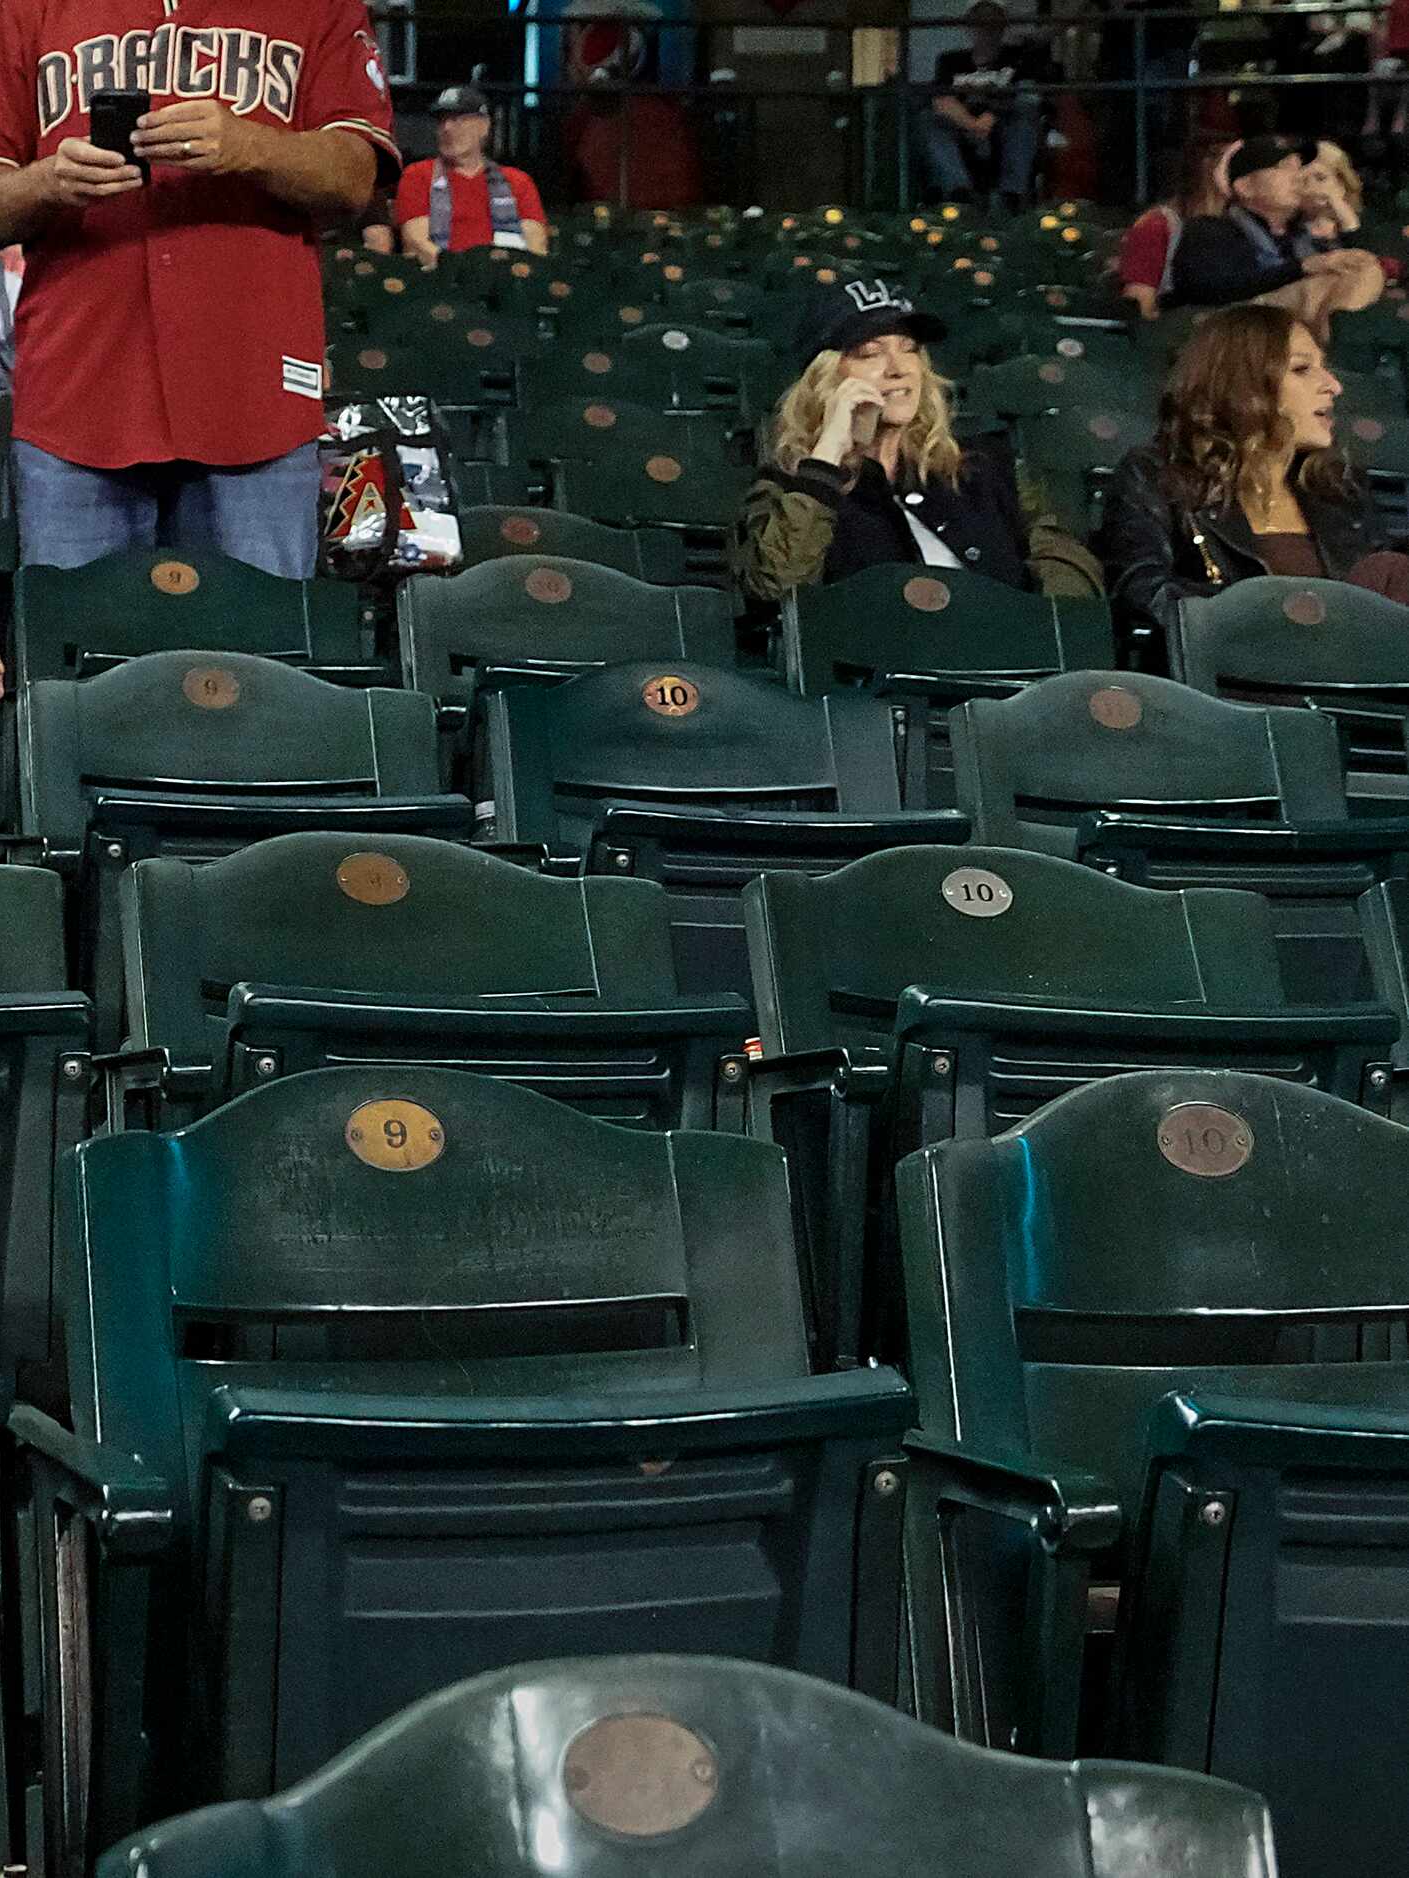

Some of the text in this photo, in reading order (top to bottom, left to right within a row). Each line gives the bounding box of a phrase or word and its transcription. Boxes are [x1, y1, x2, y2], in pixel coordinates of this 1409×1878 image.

[203, 680, 219, 697] 9
[657, 685, 689, 708] 10
[960, 882, 995, 904] 10
[382, 1119, 408, 1148] 9
[1183, 1126, 1229, 1157] 10
